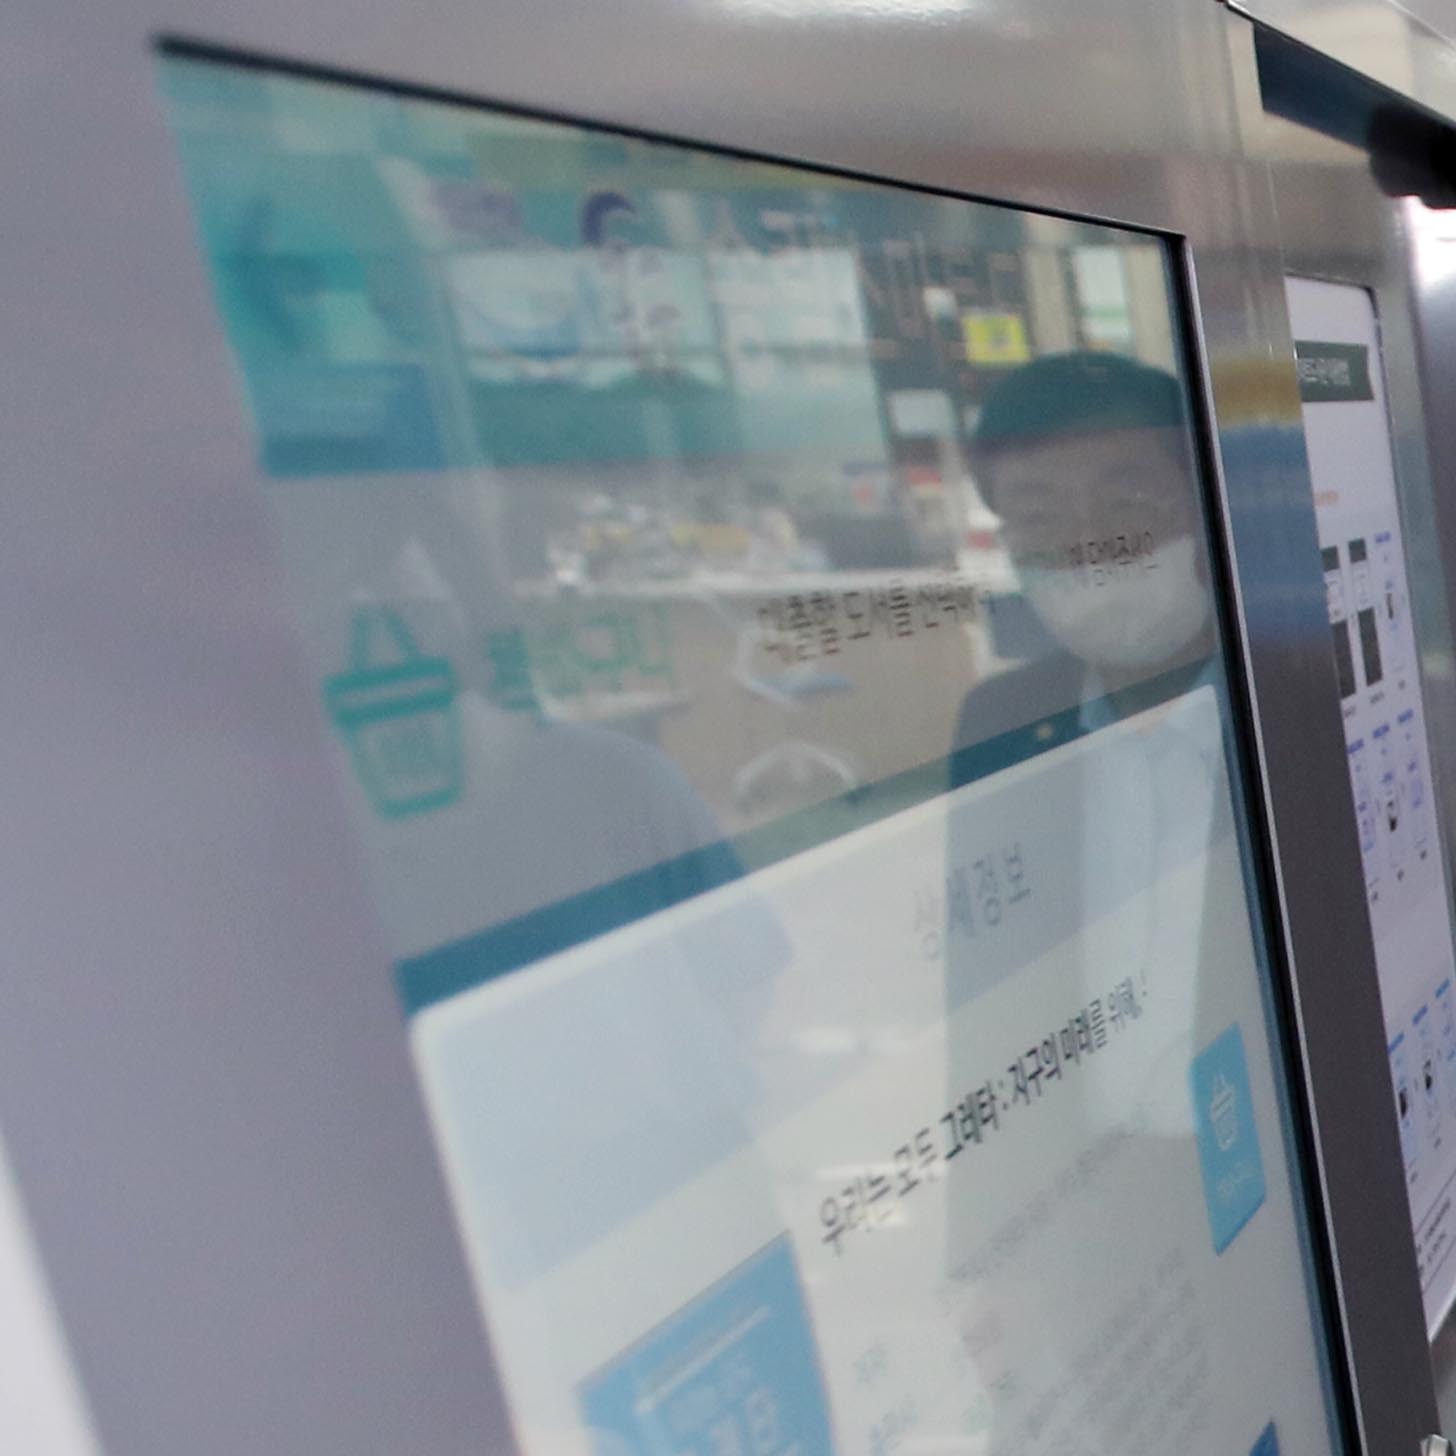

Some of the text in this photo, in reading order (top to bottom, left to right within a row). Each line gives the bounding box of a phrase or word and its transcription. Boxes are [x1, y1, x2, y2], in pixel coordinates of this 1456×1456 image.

[820, 1176, 894, 1257] 우리는
[893, 1127, 941, 1199] 모두
[941, 1079, 1000, 1162] 그레타
[1007, 1031, 1063, 1106] 지구의
[1060, 998, 1107, 1066] 미래를
